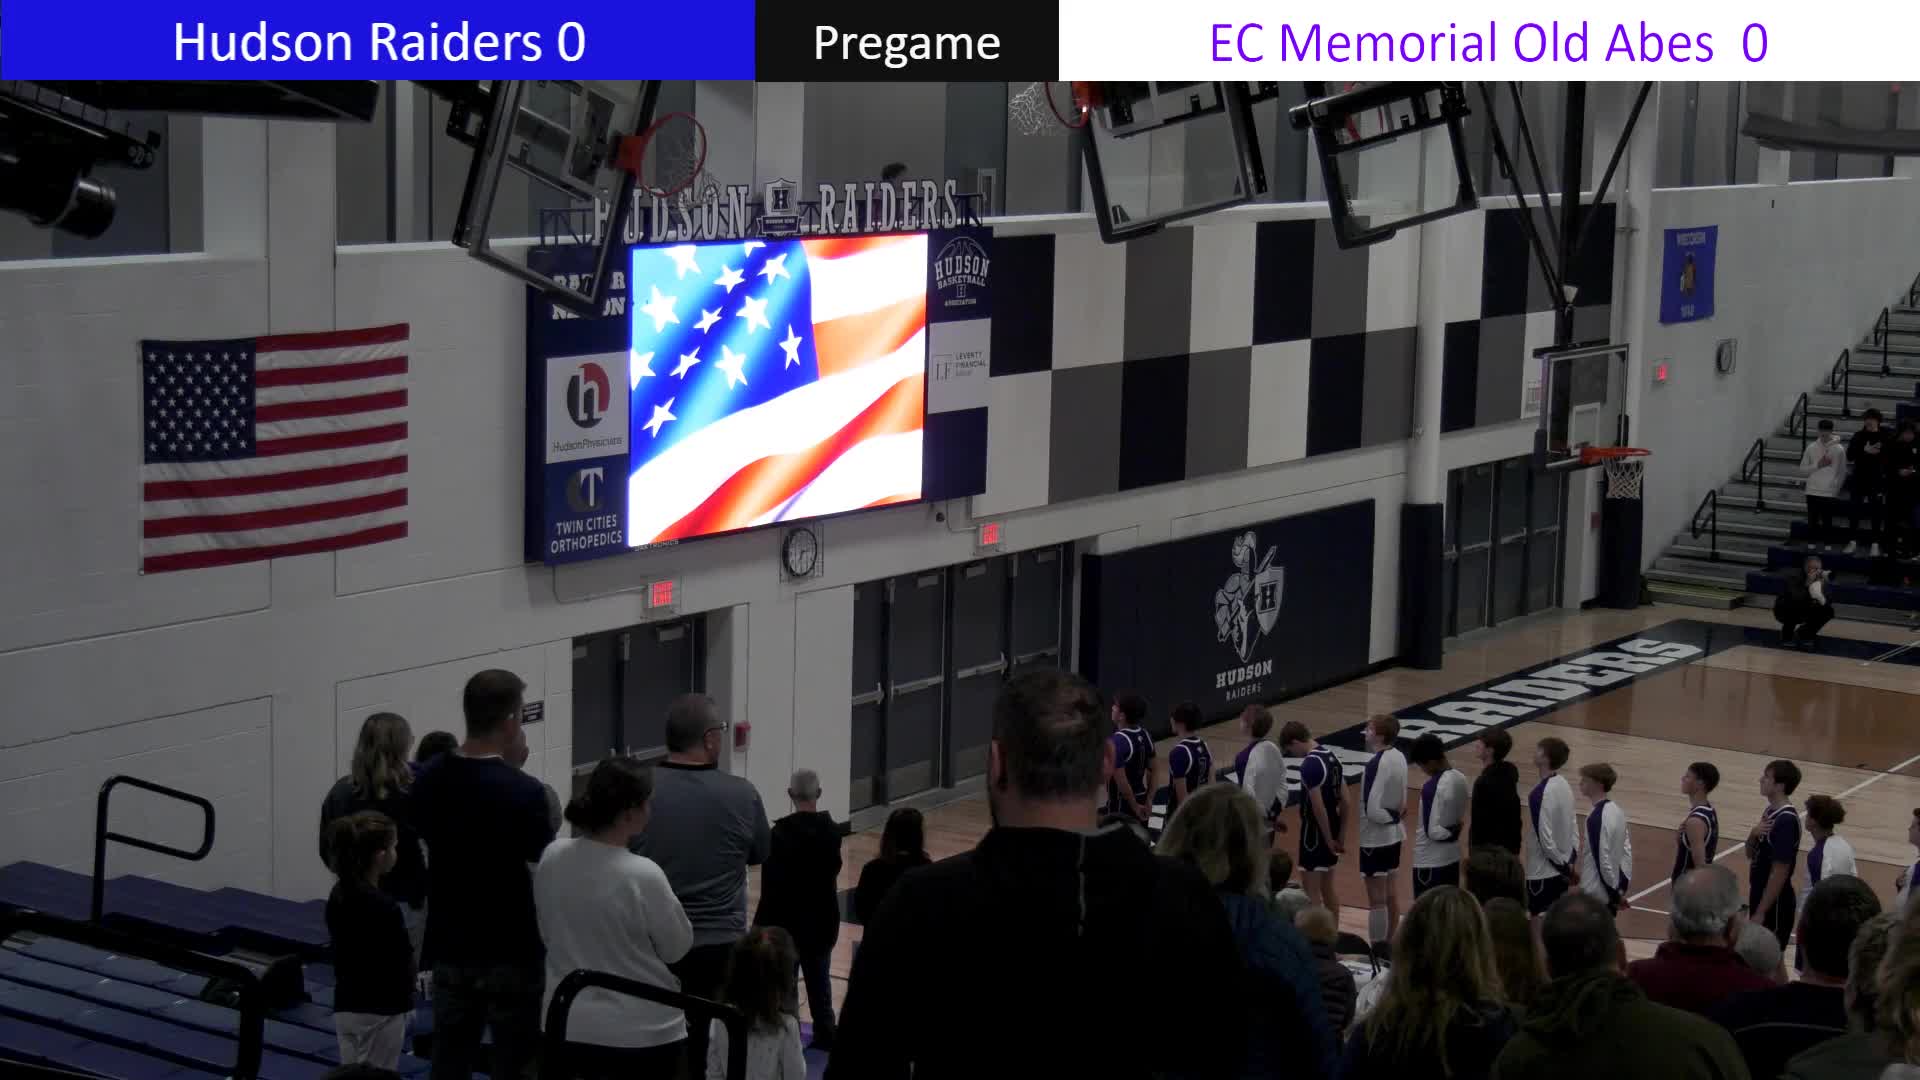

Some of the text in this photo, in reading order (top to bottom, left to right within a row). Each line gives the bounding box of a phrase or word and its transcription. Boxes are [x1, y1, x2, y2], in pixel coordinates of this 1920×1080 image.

[817, 179, 957, 234] RAIDERS
[934, 255, 990, 281] HUDSON
[937, 275, 986, 290] BASKETBALL
[556, 514, 617, 536] TWIN CITIES
[551, 530, 623, 554] ORTHOPEDICS
[1216, 659, 1273, 689] HUDSON
[1226, 682, 1262, 701] RAIDERS
[1399, 638, 1702, 743] RAIDERS
